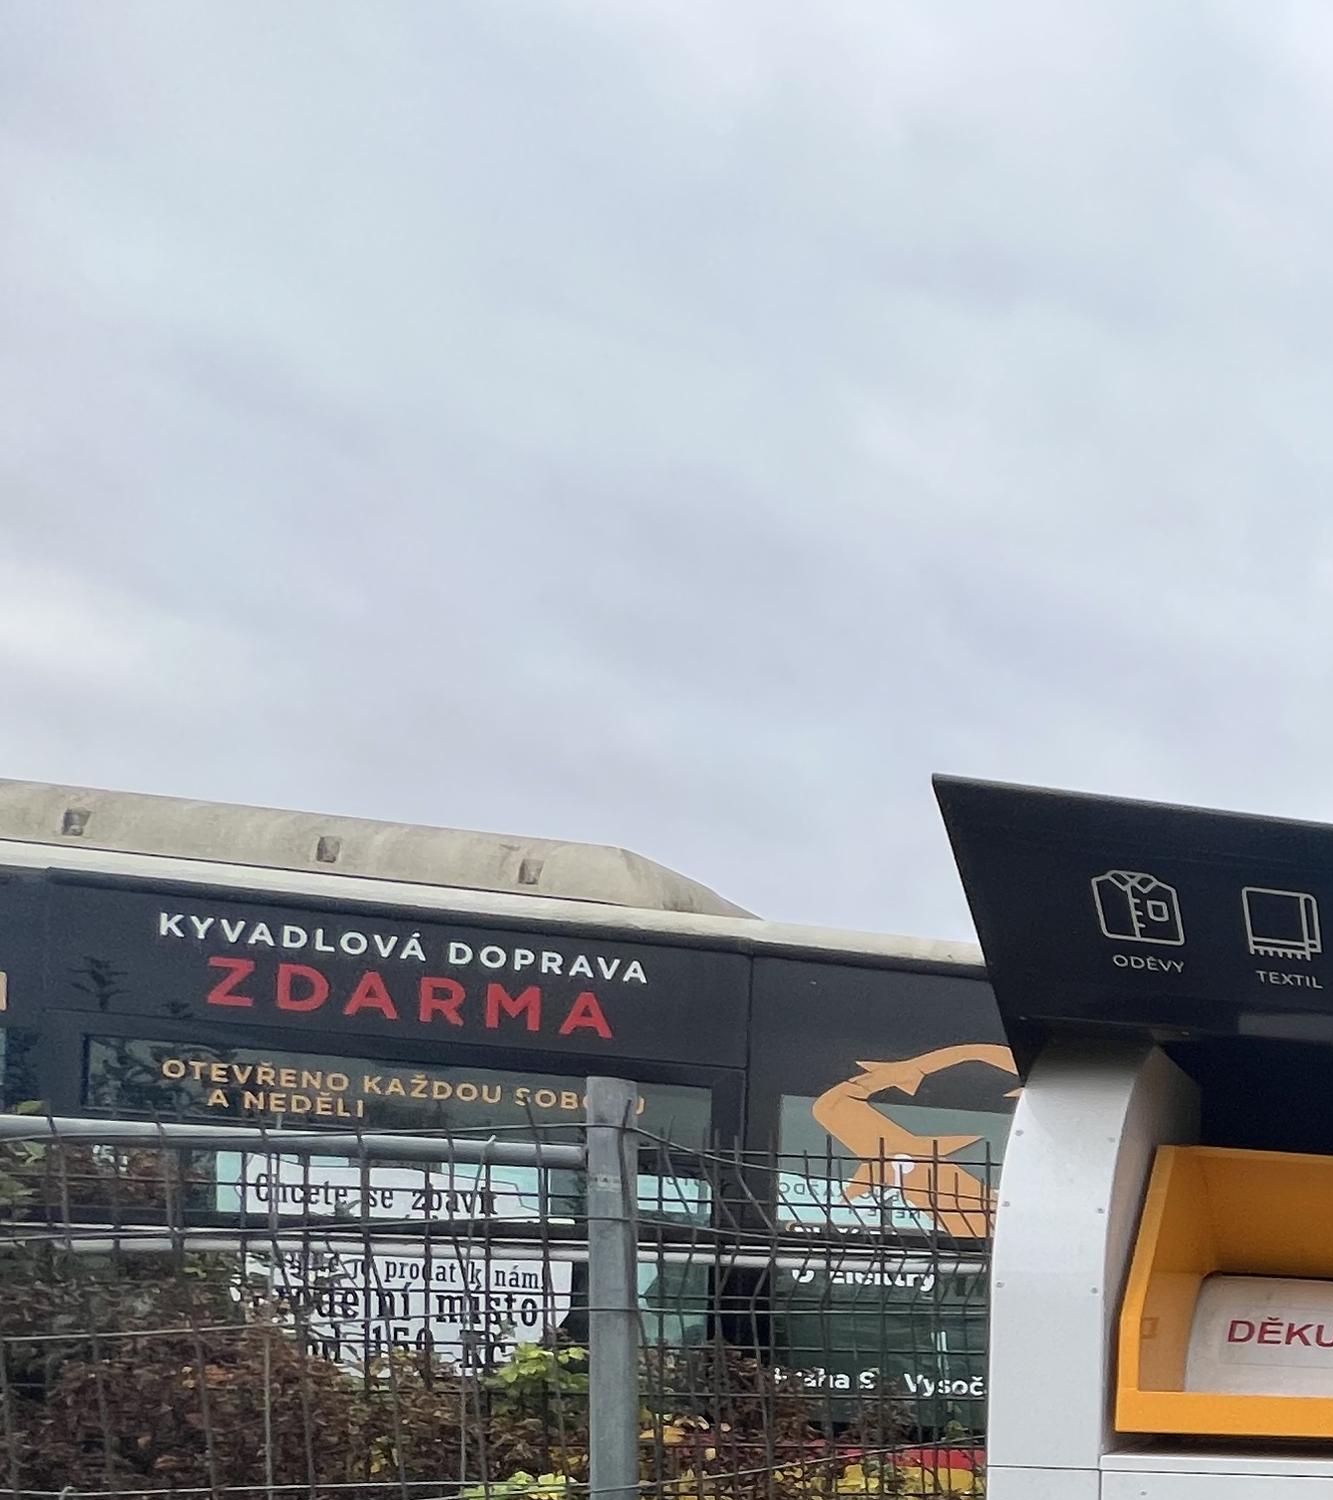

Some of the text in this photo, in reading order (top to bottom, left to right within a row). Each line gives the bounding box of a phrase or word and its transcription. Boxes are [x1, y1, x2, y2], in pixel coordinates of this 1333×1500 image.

[159, 912, 648, 984] KYVADLOVÁ DOPRAVA
[1112, 955, 1186, 974] ODĚVY
[1256, 970, 1323, 989] TEXTIL
[207, 957, 613, 1039] ZDARMA
[162, 1058, 646, 1115] OTEVŘENO KAŽDOU SOB
[207, 1088, 366, 1118] A NEDĚLI
[369, 1187, 393, 1209] se
[904, 1373, 988, 1398] Vysoč
